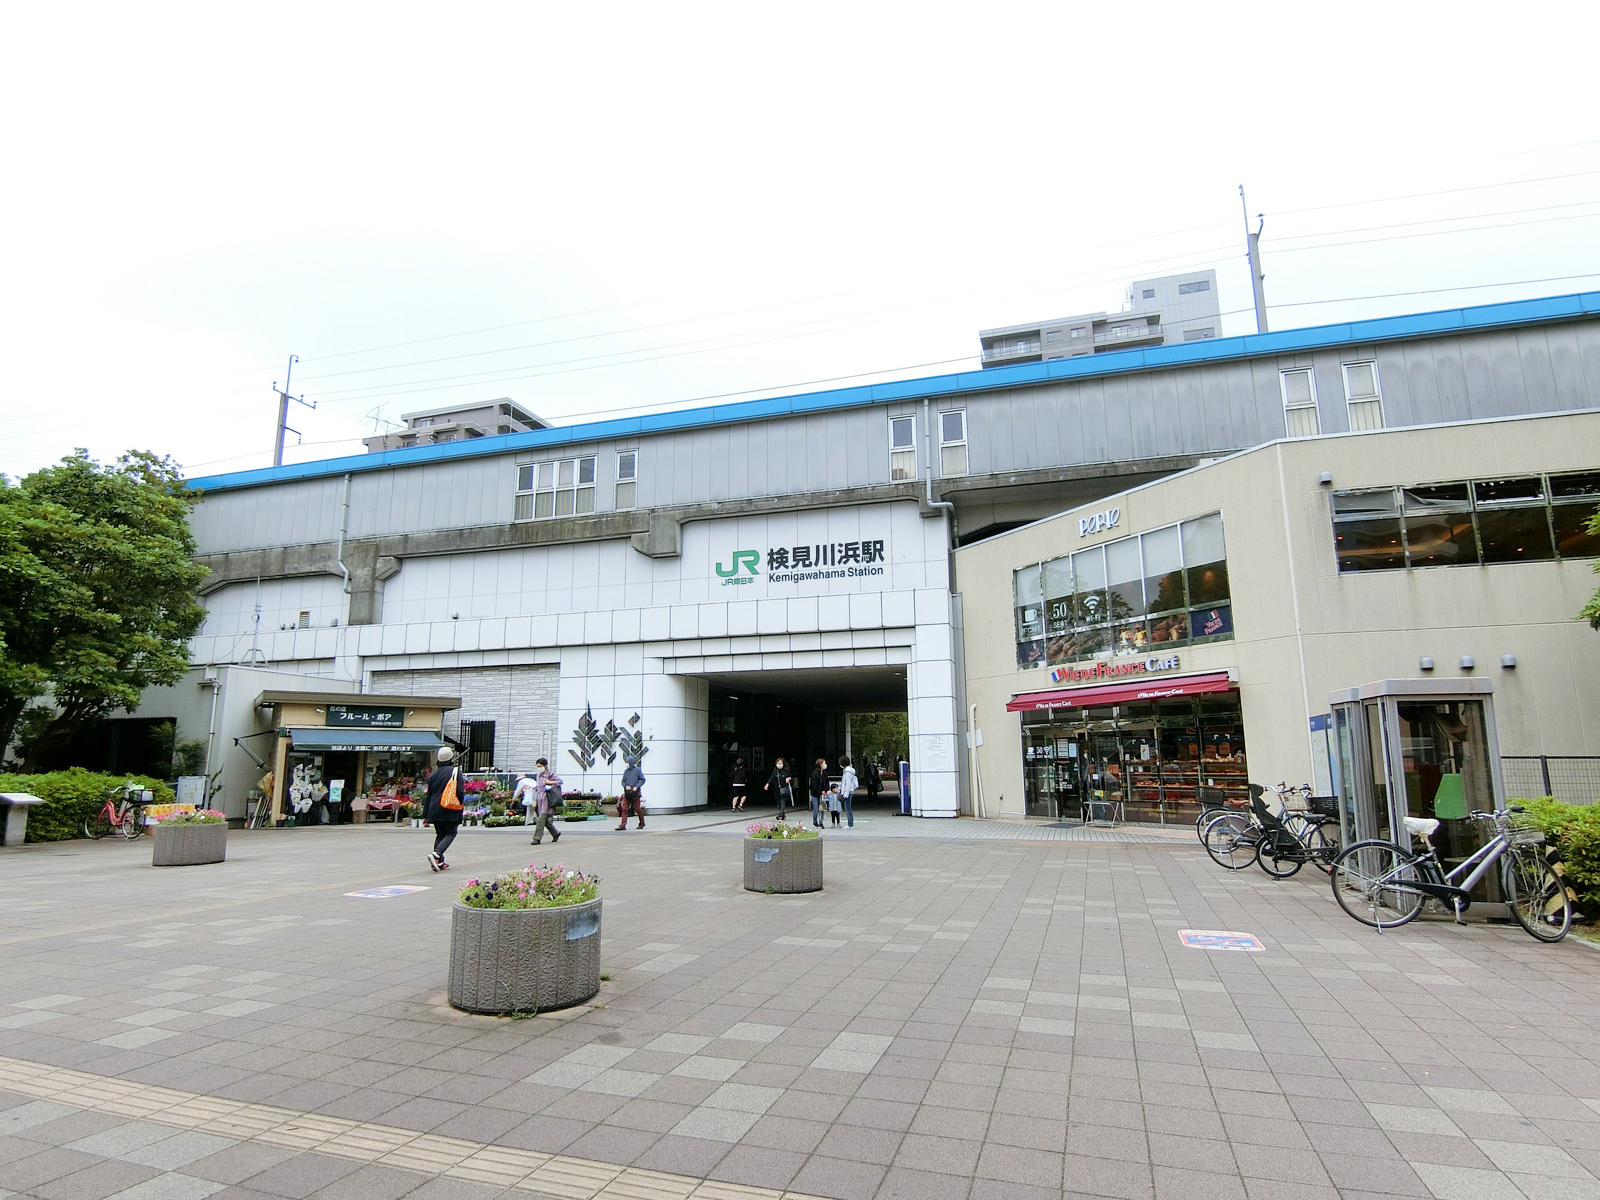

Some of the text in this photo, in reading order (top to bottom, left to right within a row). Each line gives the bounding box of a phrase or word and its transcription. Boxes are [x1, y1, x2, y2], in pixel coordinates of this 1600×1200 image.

[716, 549, 760, 577] JR
[767, 540, 885, 571] 検見川浜駅
[721, 577, 754, 586] JR東日本
[769, 566, 884, 584] Kemigawahama Station
[1053, 602, 1067, 619] 50
